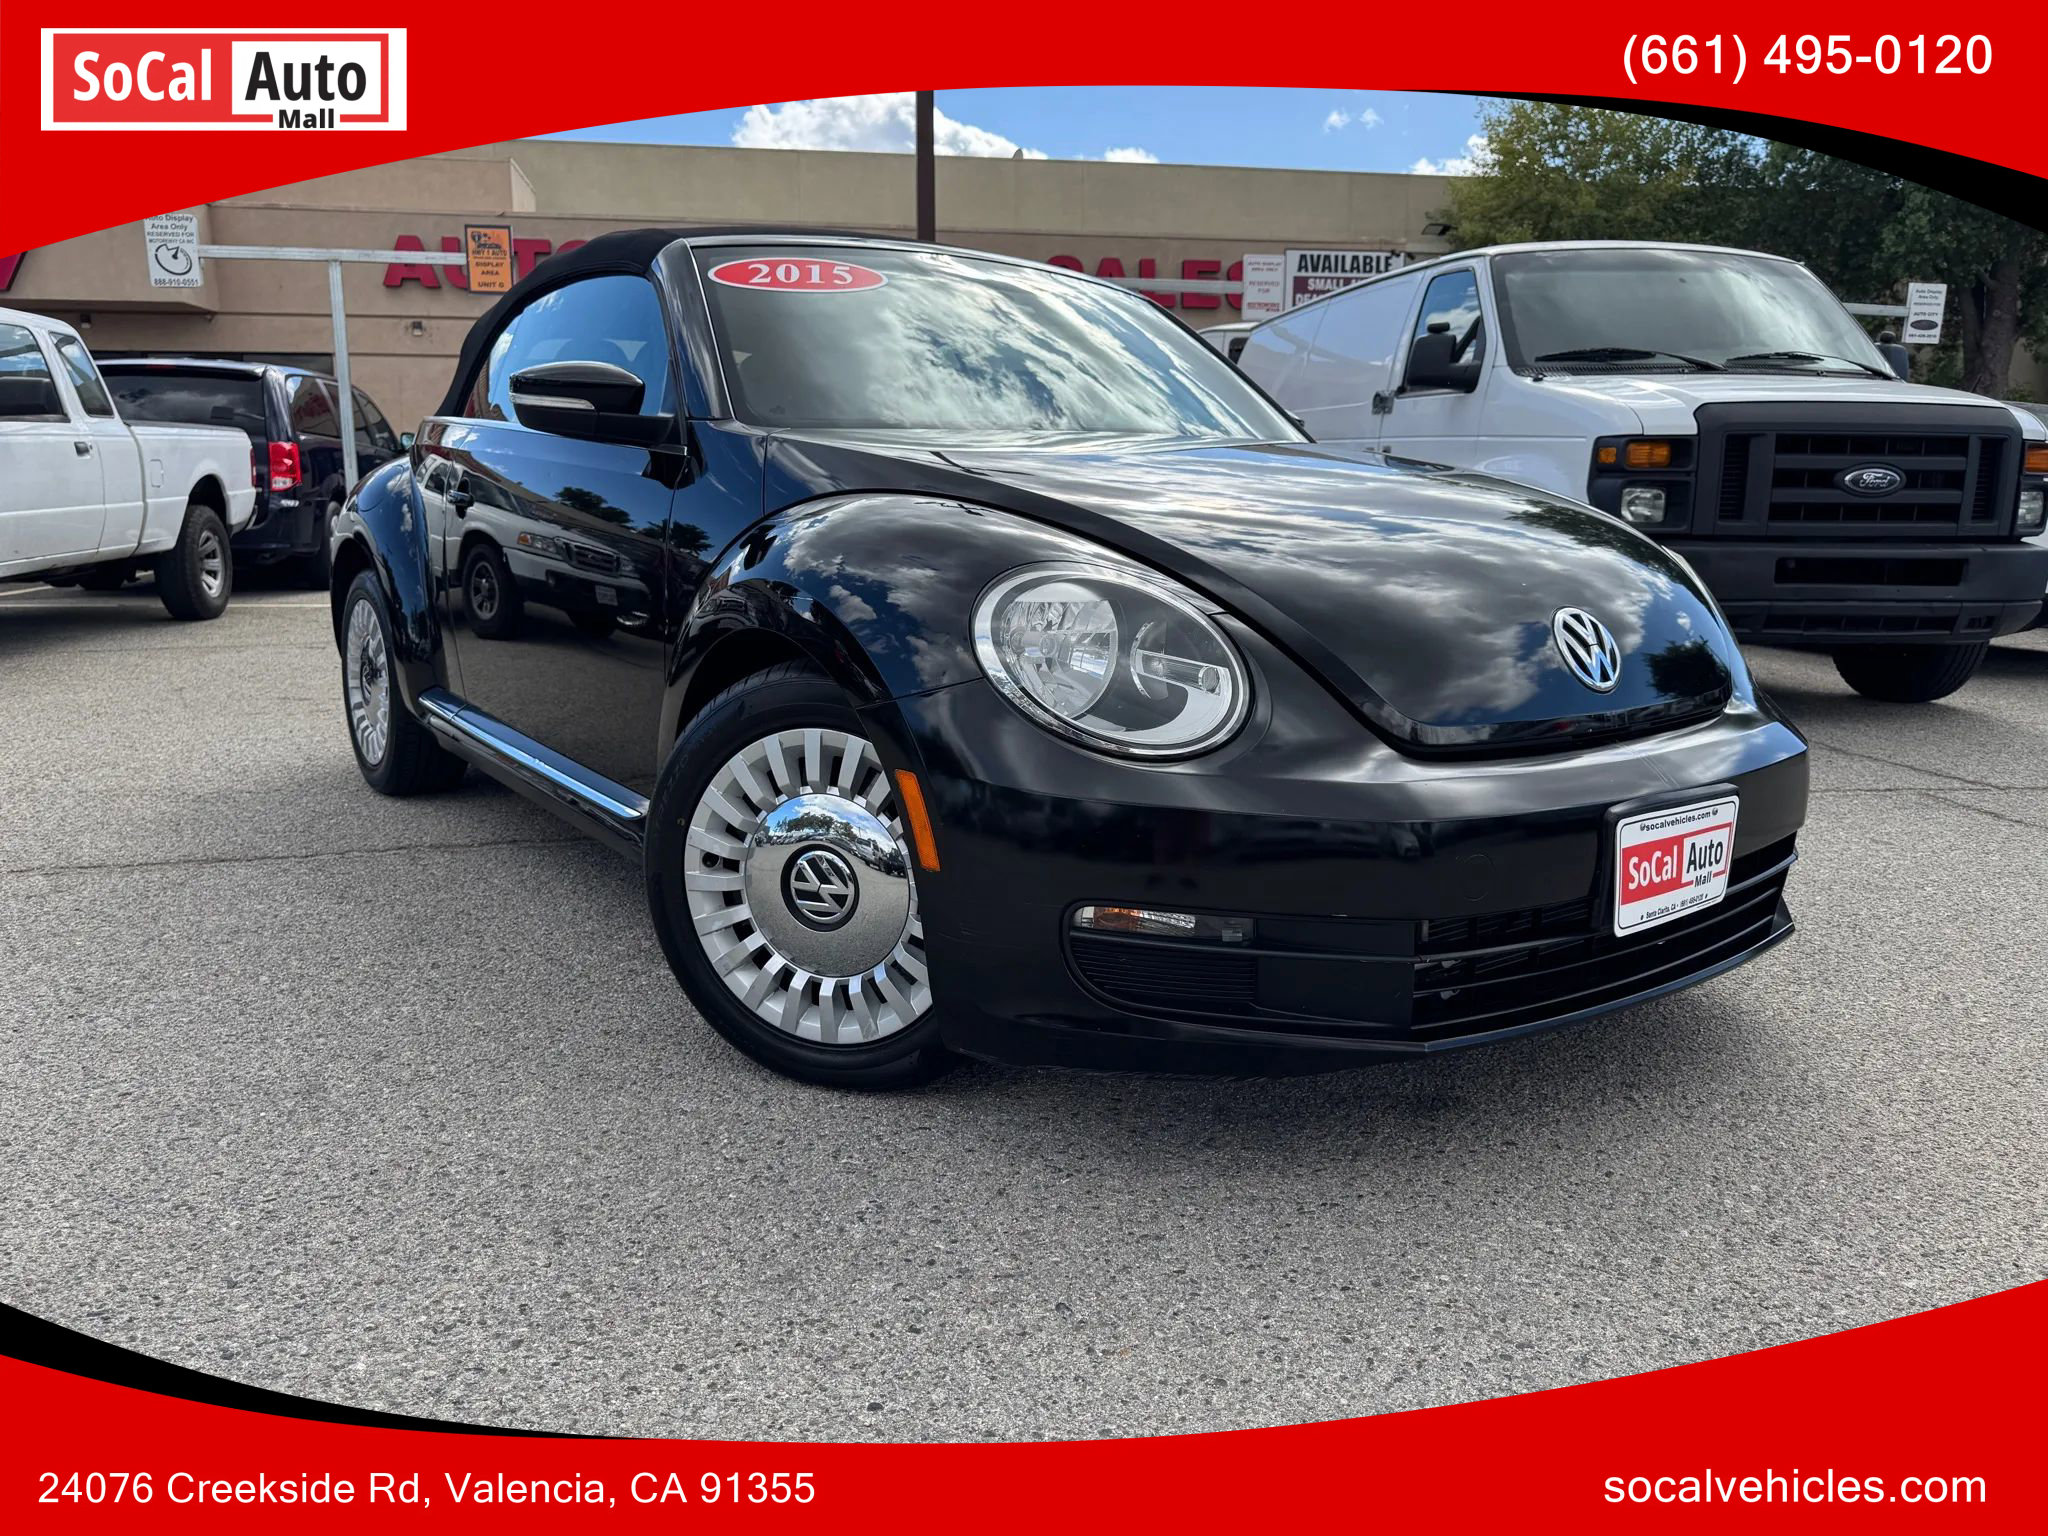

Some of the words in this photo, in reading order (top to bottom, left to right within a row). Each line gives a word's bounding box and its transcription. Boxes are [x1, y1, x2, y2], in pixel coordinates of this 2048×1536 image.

[165, 213, 194, 223] Display
[170, 223, 188, 231] Only
[1297, 254, 1393, 274] AVAILABLE
[748, 263, 853, 286] 2015
[1307, 278, 1345, 291] SMALL
[1859, 472, 1891, 488] Ford
[1645, 811, 1711, 832] socalvehicles.com
[1628, 845, 1678, 890] SoCal
[1686, 839, 1723, 874] Auto
[1694, 871, 1713, 888] Mall
